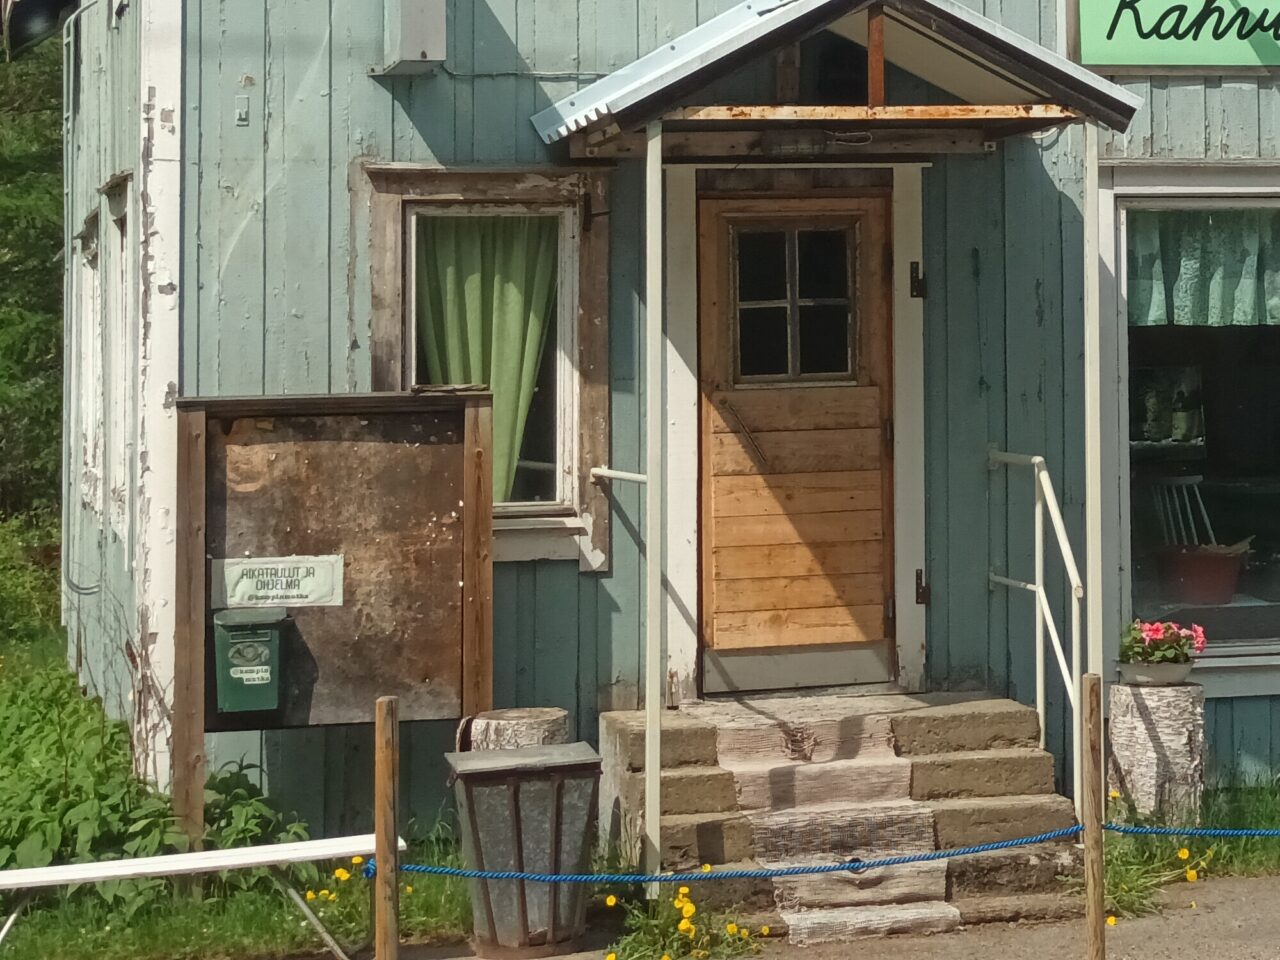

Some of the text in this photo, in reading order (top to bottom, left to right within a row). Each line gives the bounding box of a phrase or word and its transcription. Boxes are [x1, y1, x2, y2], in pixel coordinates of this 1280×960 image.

[241, 567, 315, 579] AIKATAULUT JA
[256, 579, 300, 591] OHJELMA
